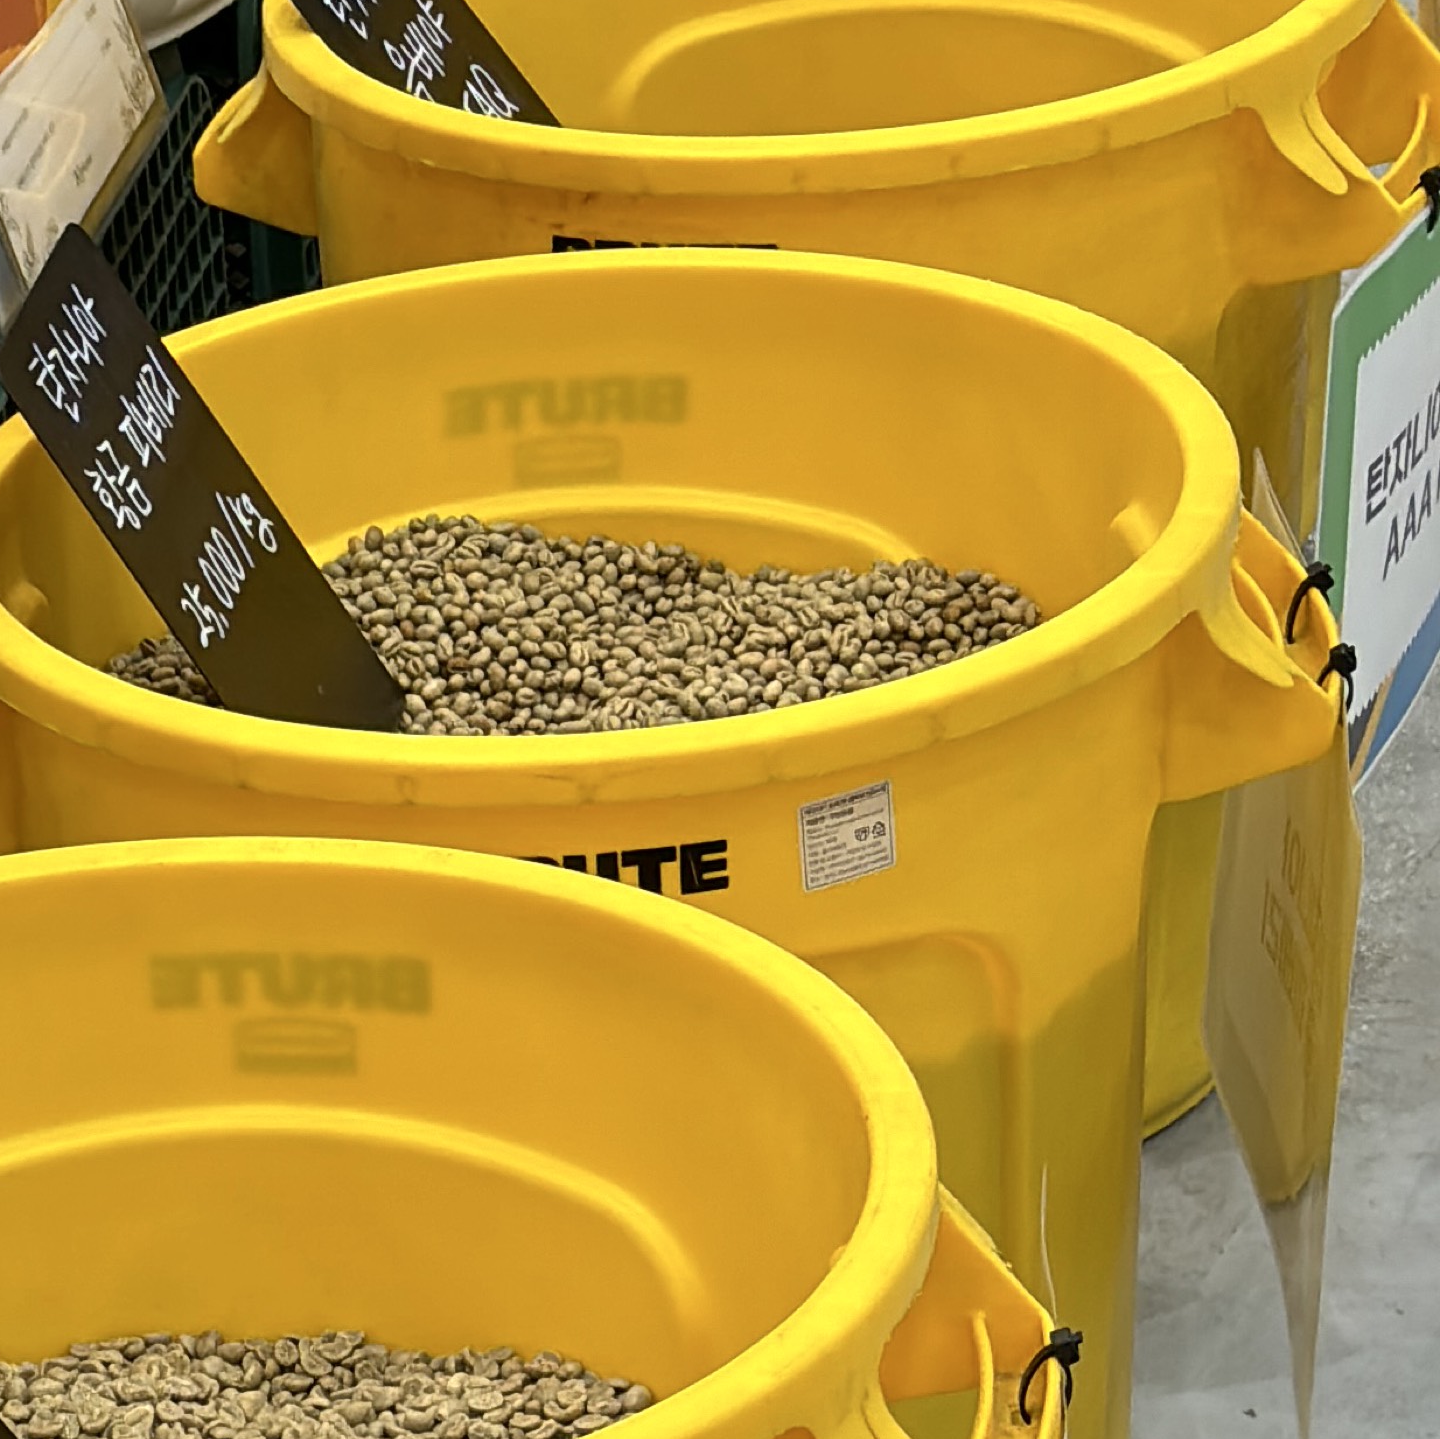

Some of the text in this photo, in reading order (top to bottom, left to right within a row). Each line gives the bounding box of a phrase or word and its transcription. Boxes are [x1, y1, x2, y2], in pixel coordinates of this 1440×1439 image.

[28, 283, 107, 424] 탄자니아
[118, 345, 182, 468] 피베리
[1382, 468, 1431, 581] AAA
